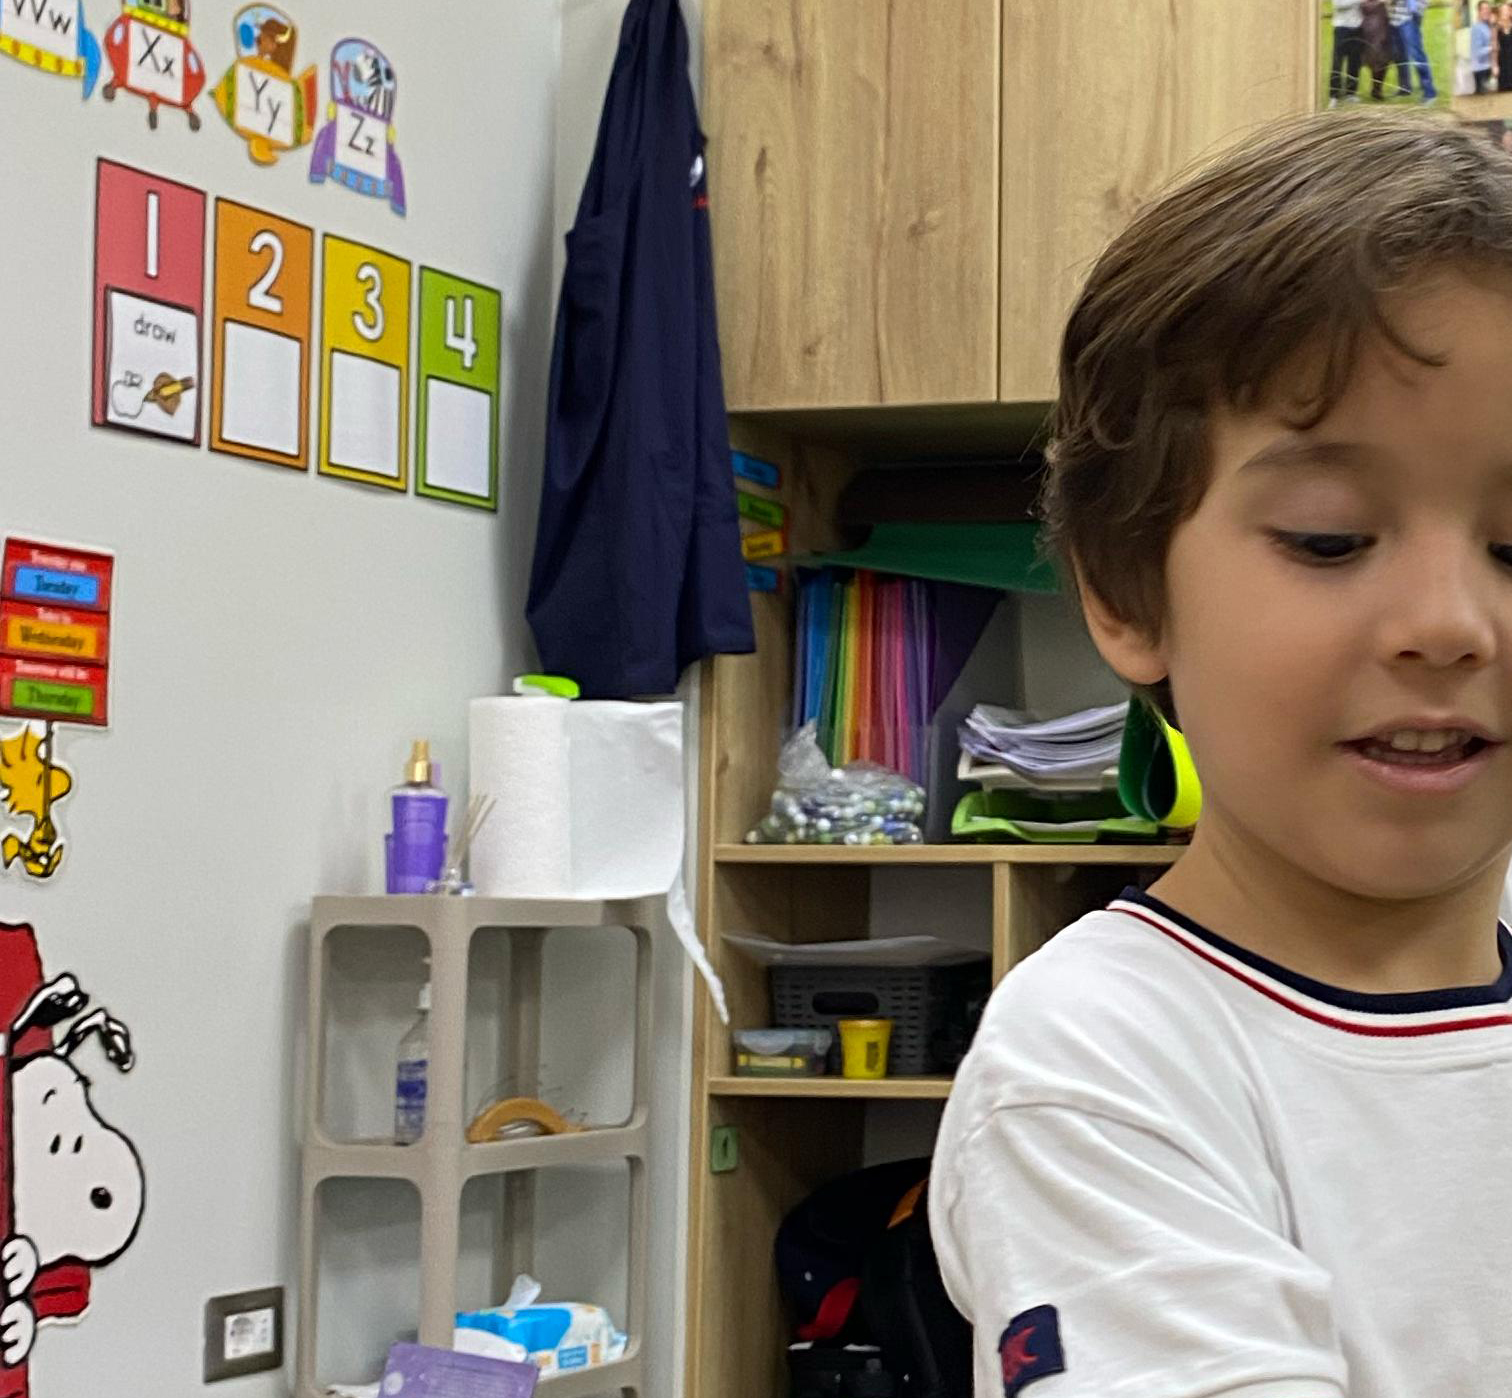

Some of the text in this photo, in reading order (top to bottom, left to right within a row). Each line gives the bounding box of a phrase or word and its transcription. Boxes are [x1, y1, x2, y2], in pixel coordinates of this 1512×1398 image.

[138, 28, 174, 77] Xx
[248, 72, 283, 133] Yy
[347, 114, 376, 157] Zz
[247, 229, 285, 314] 2
[350, 262, 386, 341] 3
[133, 314, 177, 345] draw
[443, 295, 478, 370] 4
